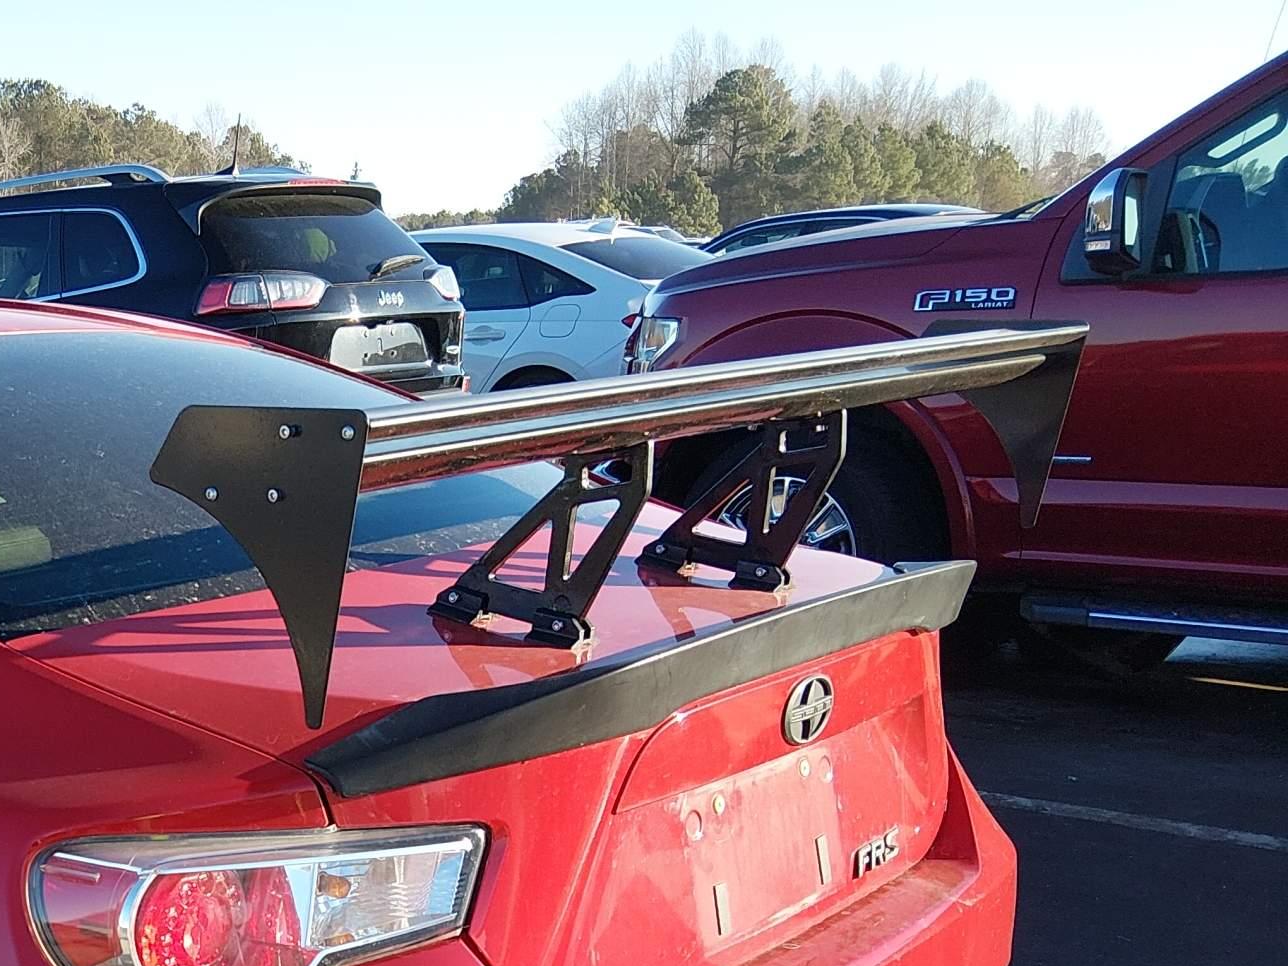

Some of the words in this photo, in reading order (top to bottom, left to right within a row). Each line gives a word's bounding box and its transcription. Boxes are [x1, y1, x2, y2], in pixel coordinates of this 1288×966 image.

[378, 290, 404, 307] Jeep
[914, 288, 1016, 311] F150
[852, 825, 900, 880] FRS
